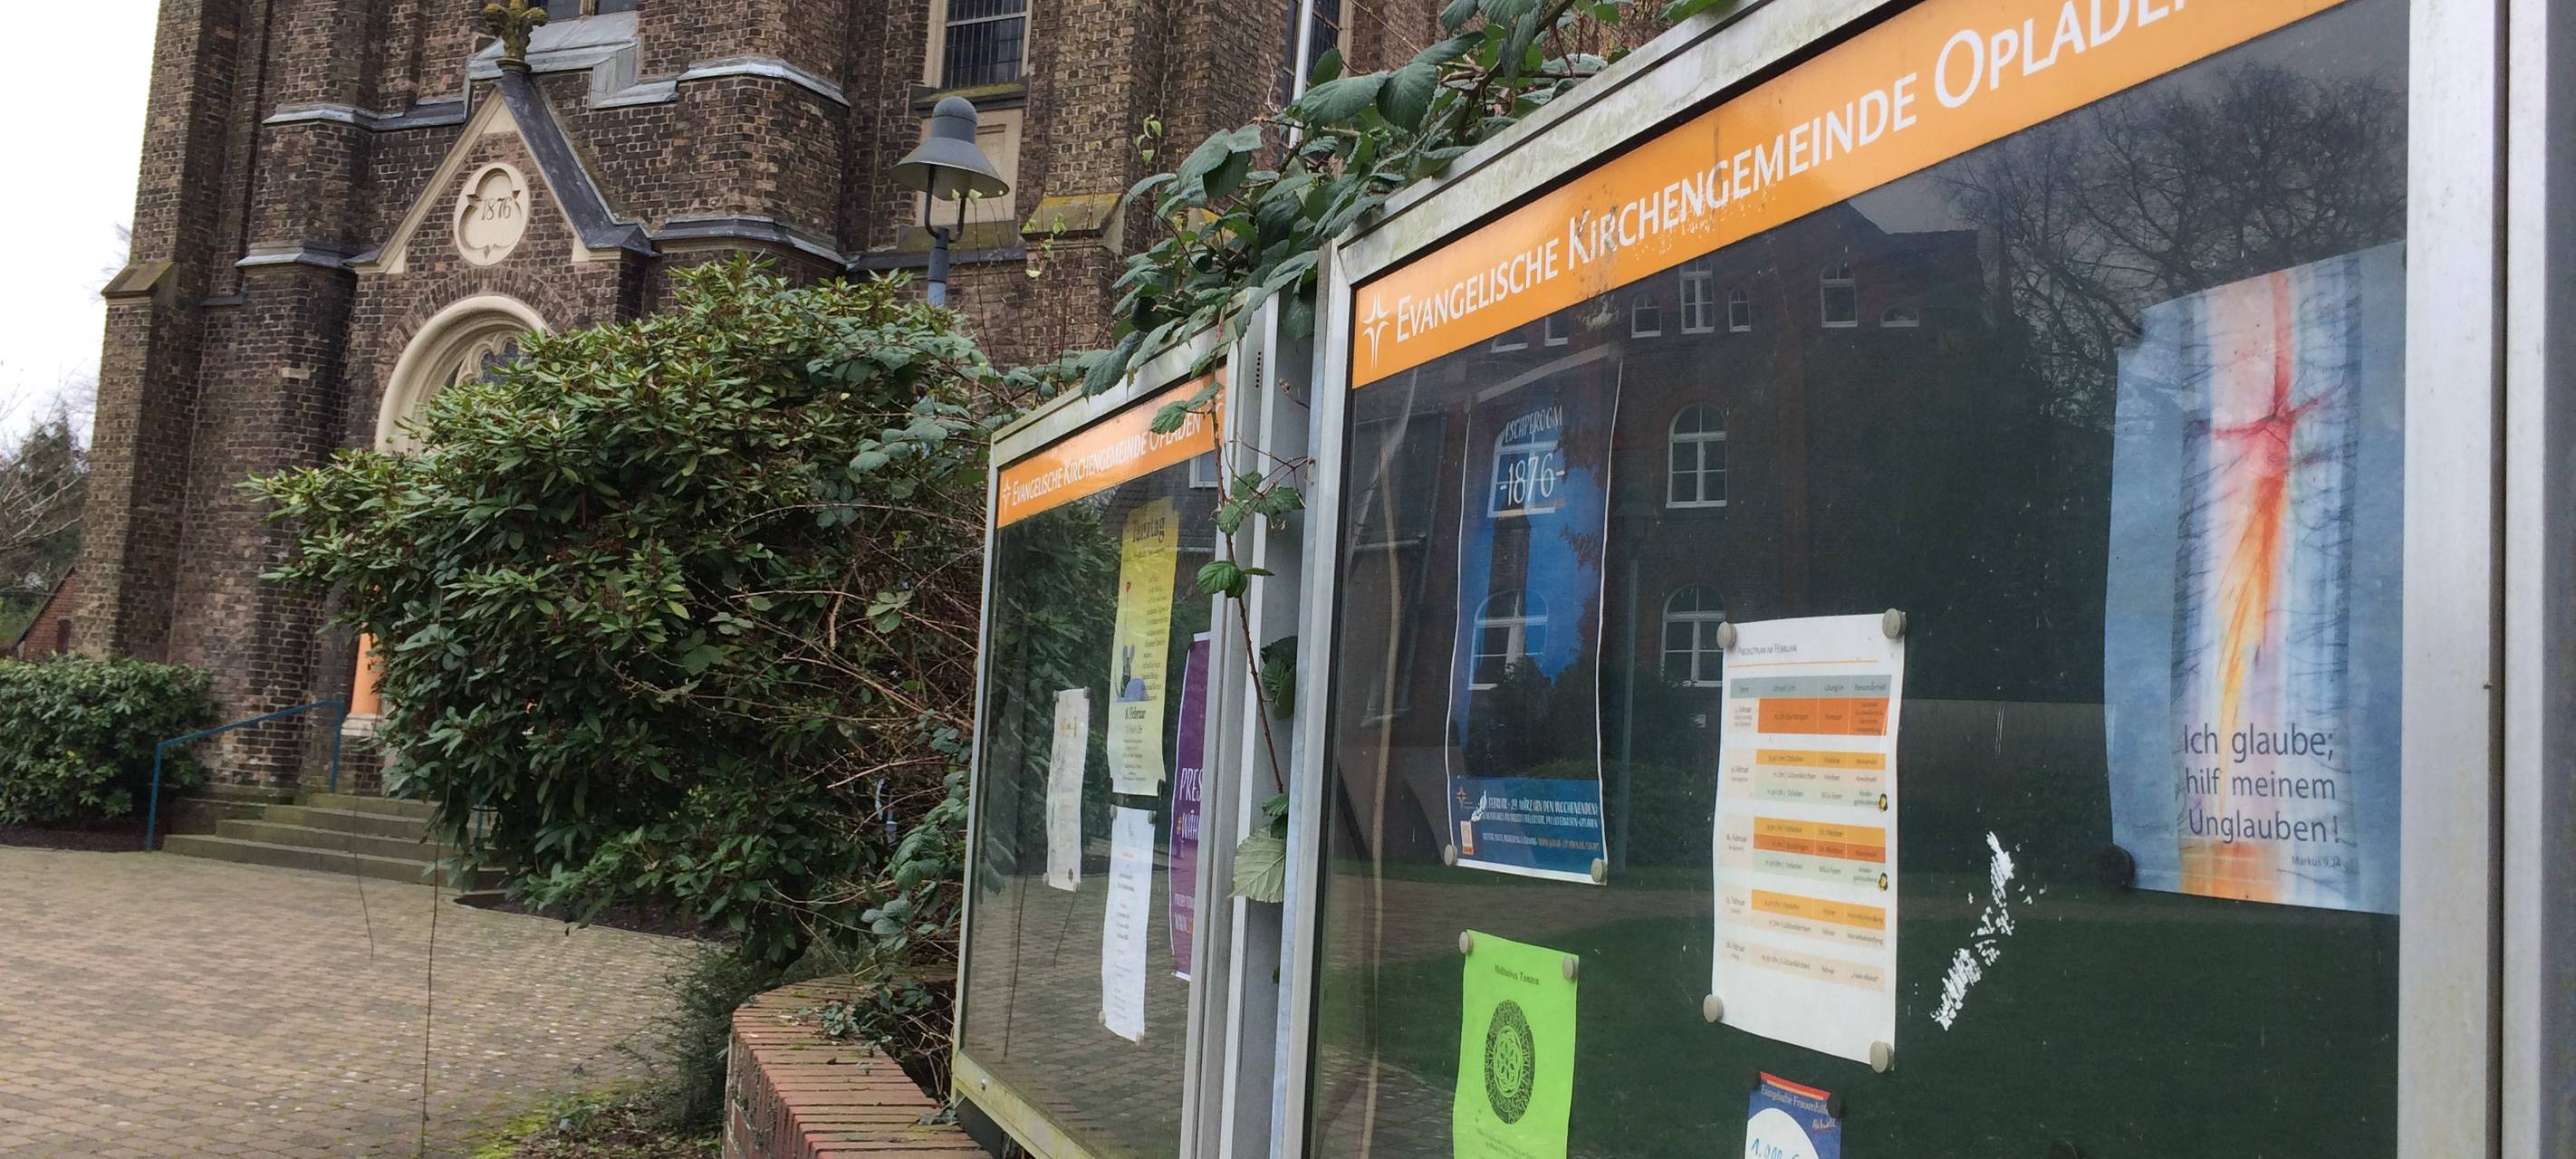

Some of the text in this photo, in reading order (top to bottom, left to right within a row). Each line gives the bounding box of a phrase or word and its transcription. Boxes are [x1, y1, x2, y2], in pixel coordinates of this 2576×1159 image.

[1396, 0, 2186, 342] EVANGELISCHE KIRCHENGEMEINDE OPLAD
[481, 196, 513, 221] 1876
[2184, 722, 2334, 763] Ich glaube;
[2186, 767, 2336, 800] hilf meinem
[2188, 808, 2341, 844] Unglauben!
[1793, 1096, 1830, 1116] Frauenhilf
